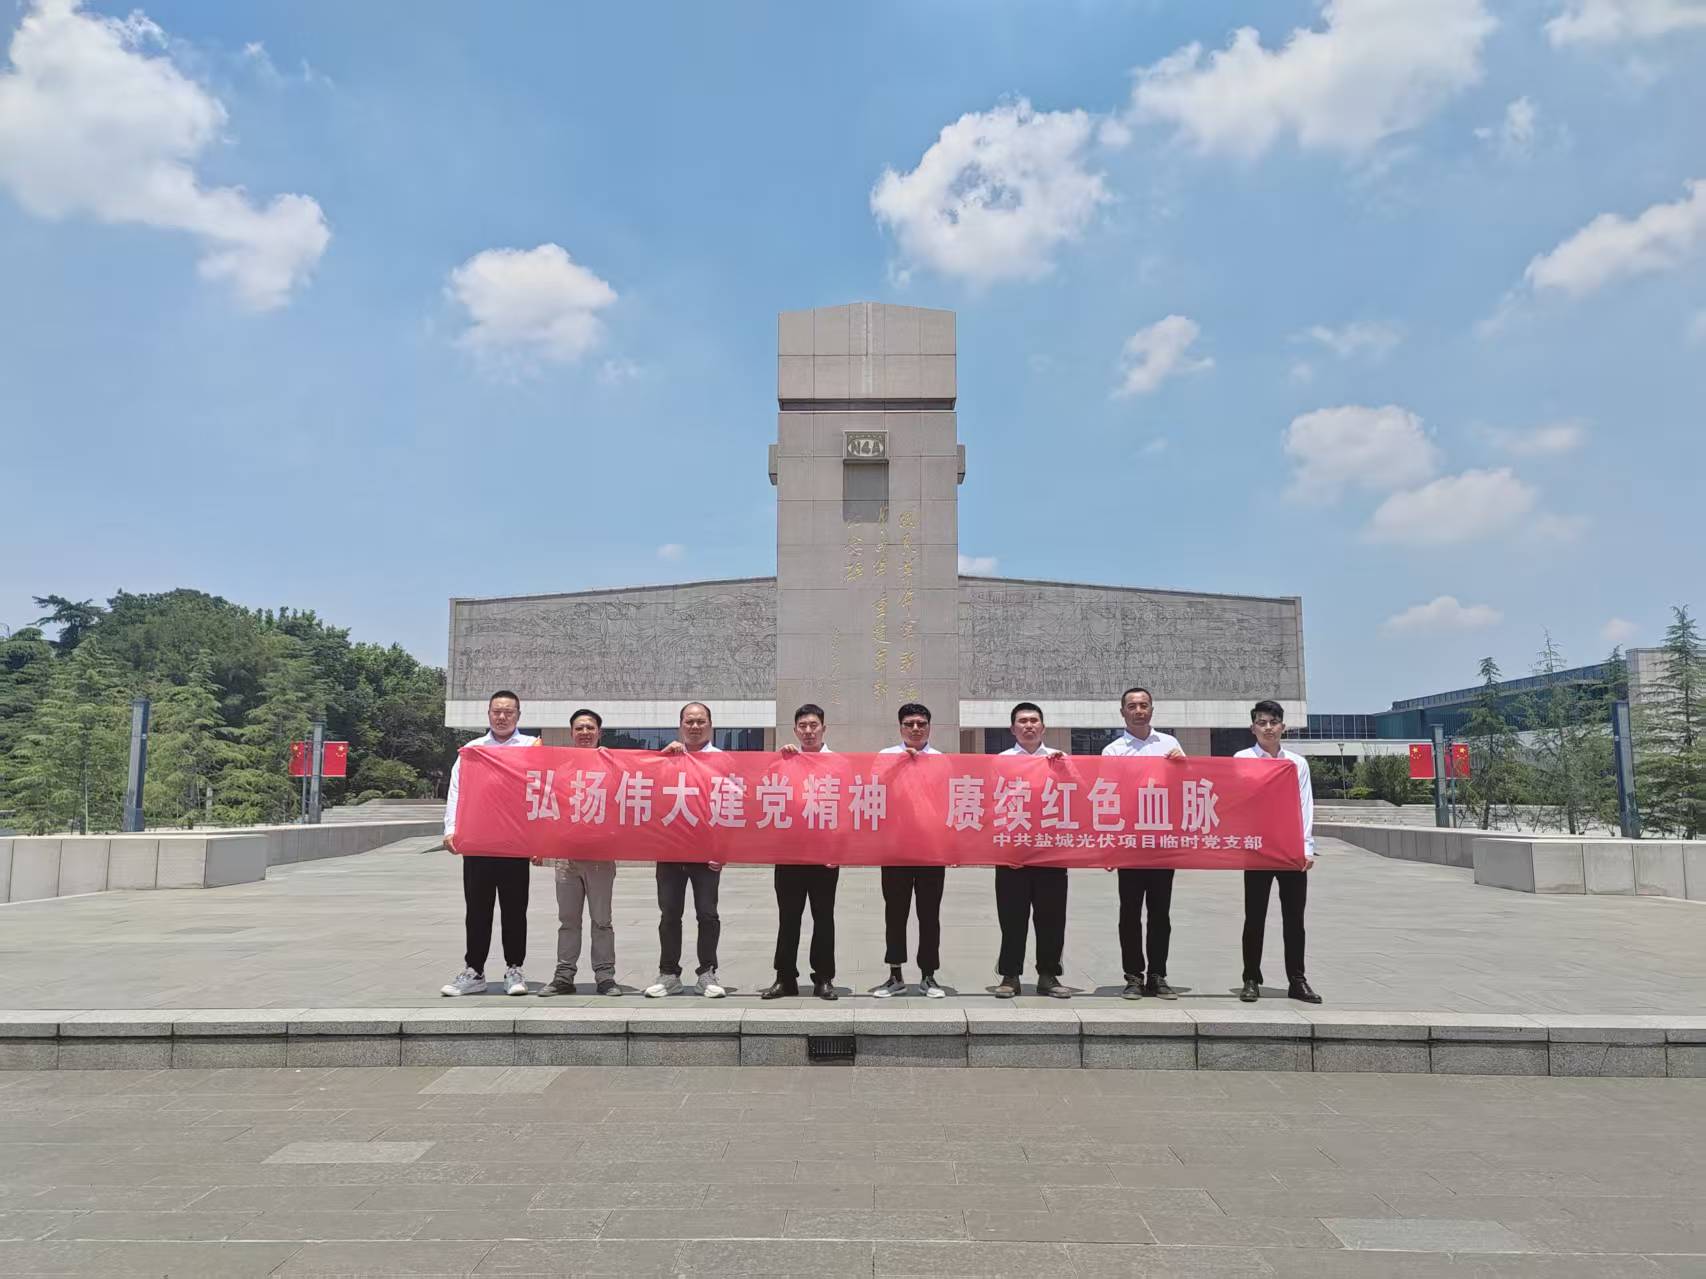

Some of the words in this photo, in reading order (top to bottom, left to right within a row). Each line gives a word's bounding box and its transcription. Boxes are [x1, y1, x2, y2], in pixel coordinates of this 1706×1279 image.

[850, 439, 881, 455] N4A
[526, 769, 886, 831] 弘扬伟大建党精神
[946, 775, 1220, 833] 赓续红色血脉
[993, 832, 1263, 850] 中共盐城光伏项目临时党支部
